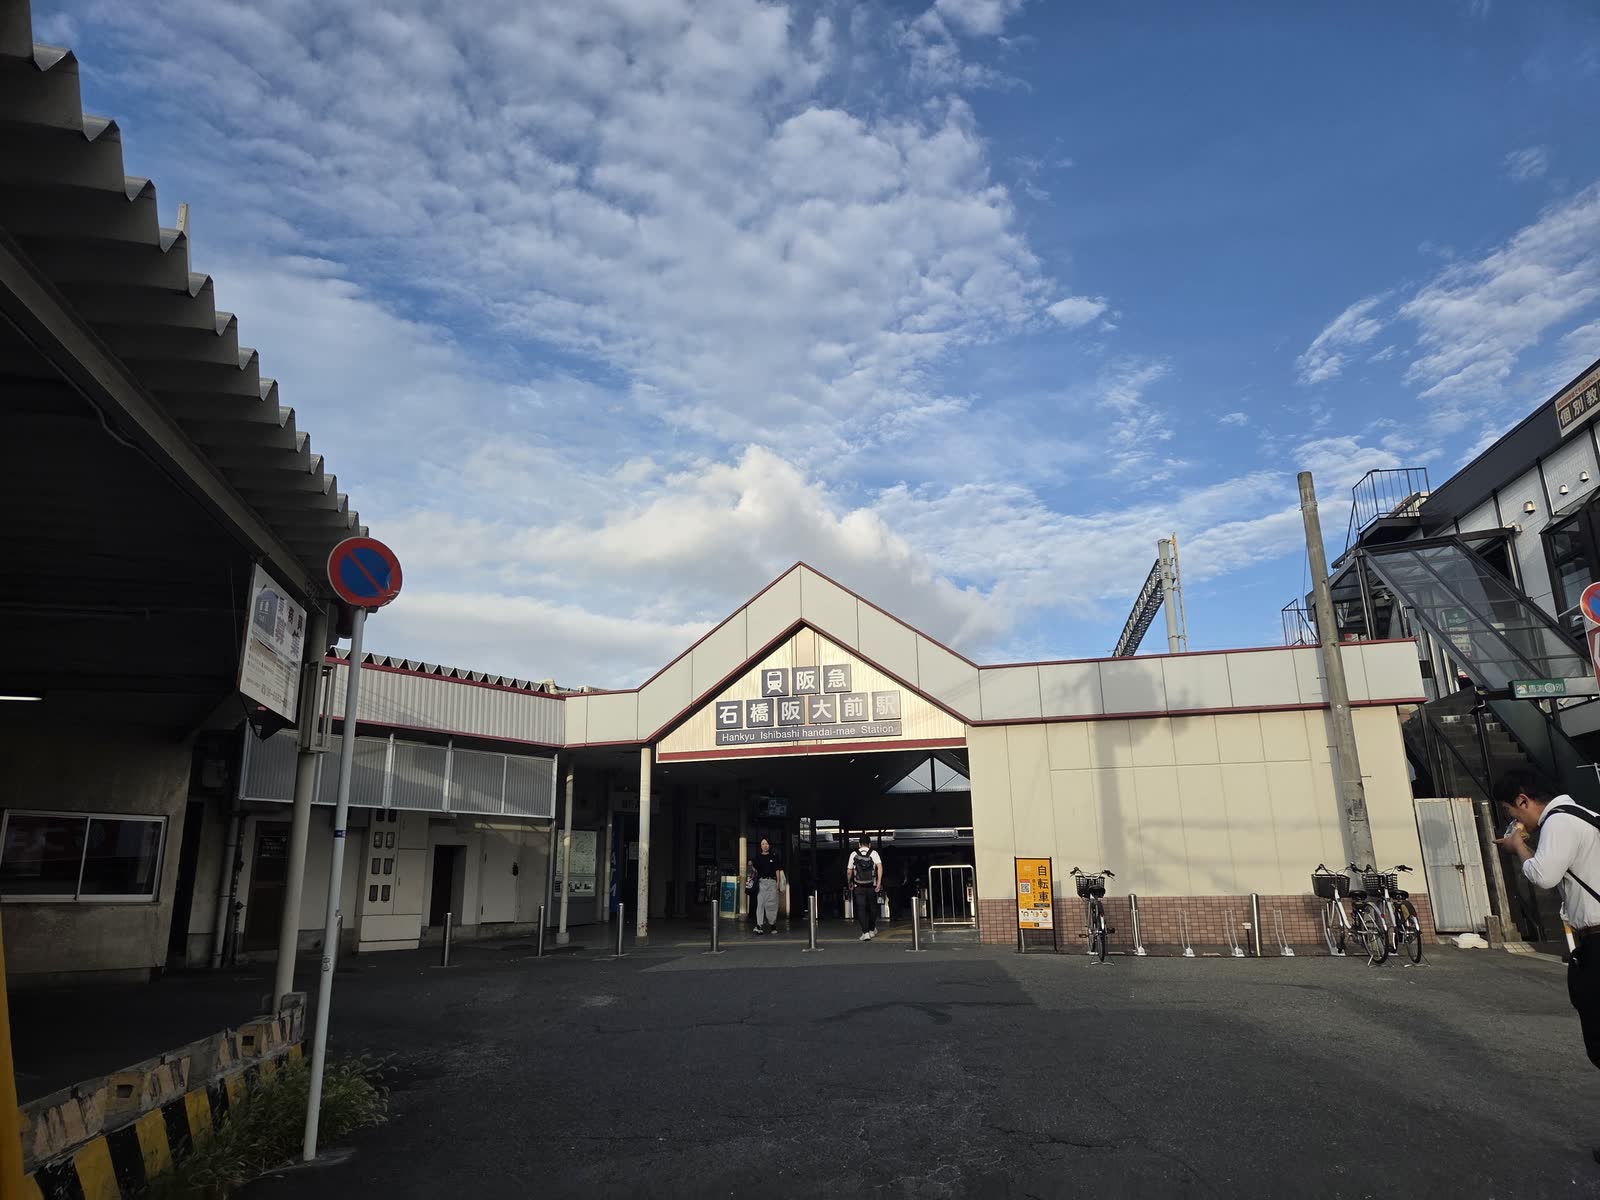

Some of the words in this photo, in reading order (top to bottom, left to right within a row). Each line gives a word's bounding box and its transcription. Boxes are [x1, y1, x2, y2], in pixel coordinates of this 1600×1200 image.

[1560, 383, 1600, 426] 個別教
[796, 669, 846, 690] 阪急
[719, 696, 896, 724] 石橋阪大前駅
[722, 732, 755, 743] Hankyu
[760, 730, 800, 740] Ishibashi
[802, 727, 856, 738] handai-mae
[861, 725, 894, 735] Station
[1038, 865, 1049, 902] 自転車
